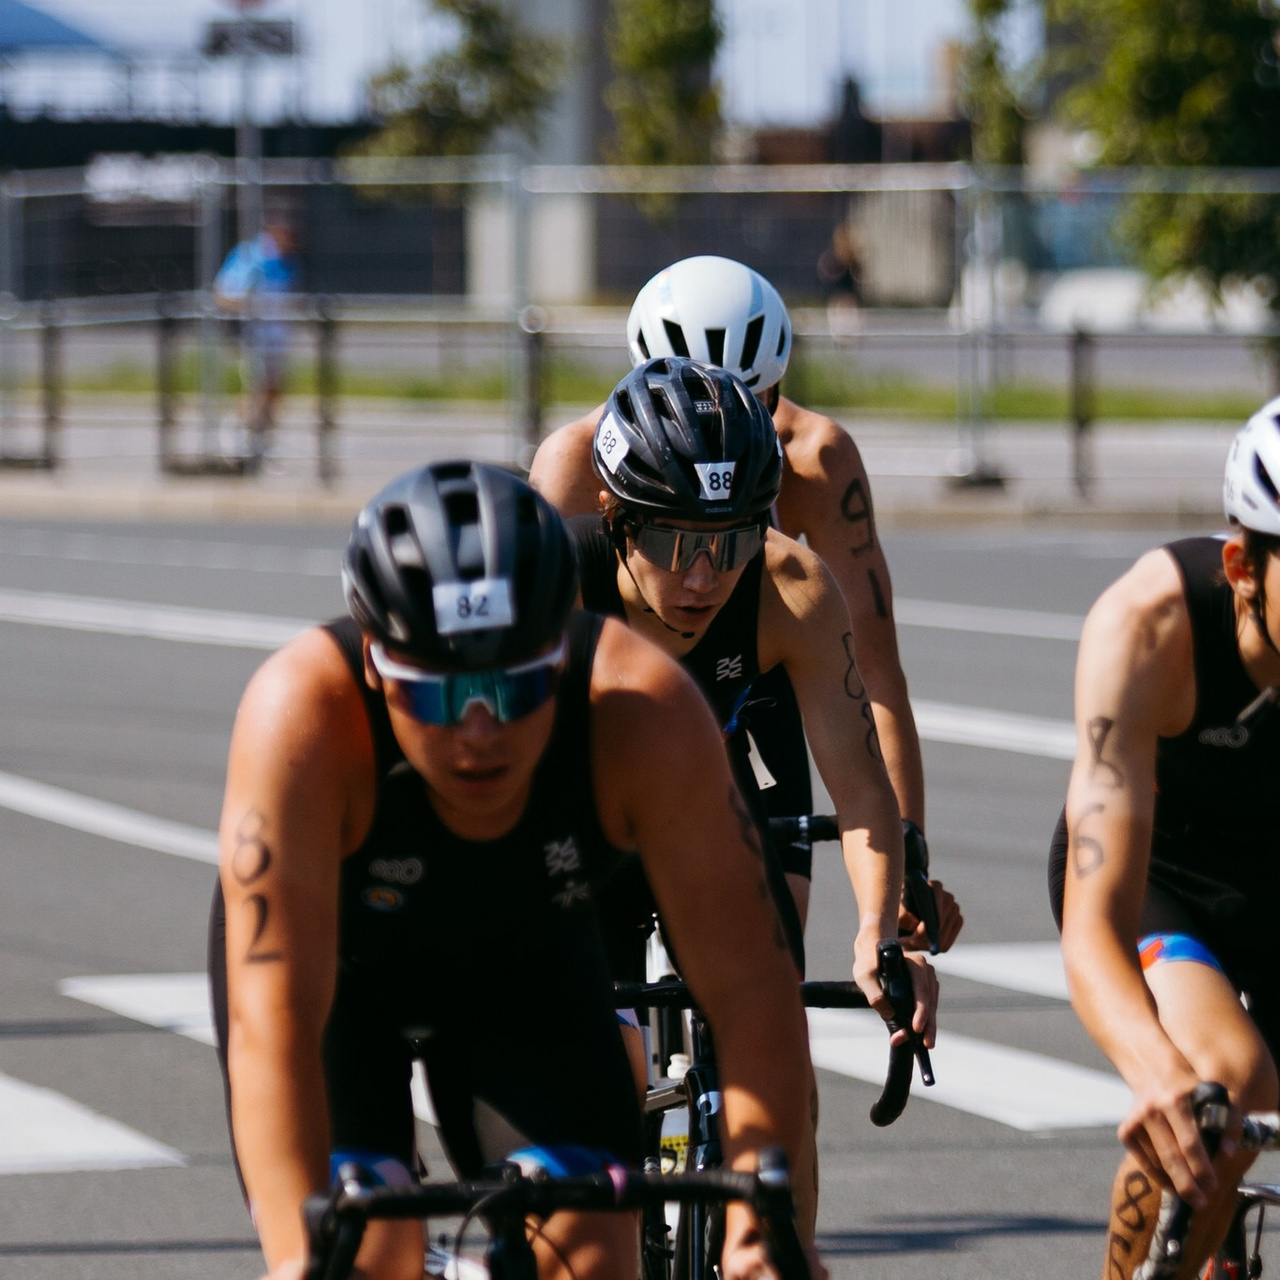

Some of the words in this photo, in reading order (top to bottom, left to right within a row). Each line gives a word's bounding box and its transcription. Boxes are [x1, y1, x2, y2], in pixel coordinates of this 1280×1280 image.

[602, 430, 617, 455] 88
[709, 471, 733, 491] 88
[456, 595, 489, 619] 82
[840, 477, 886, 619] 91
[842, 632, 882, 760] 88
[1073, 716, 1125, 880] 86
[232, 808, 285, 965] 82
